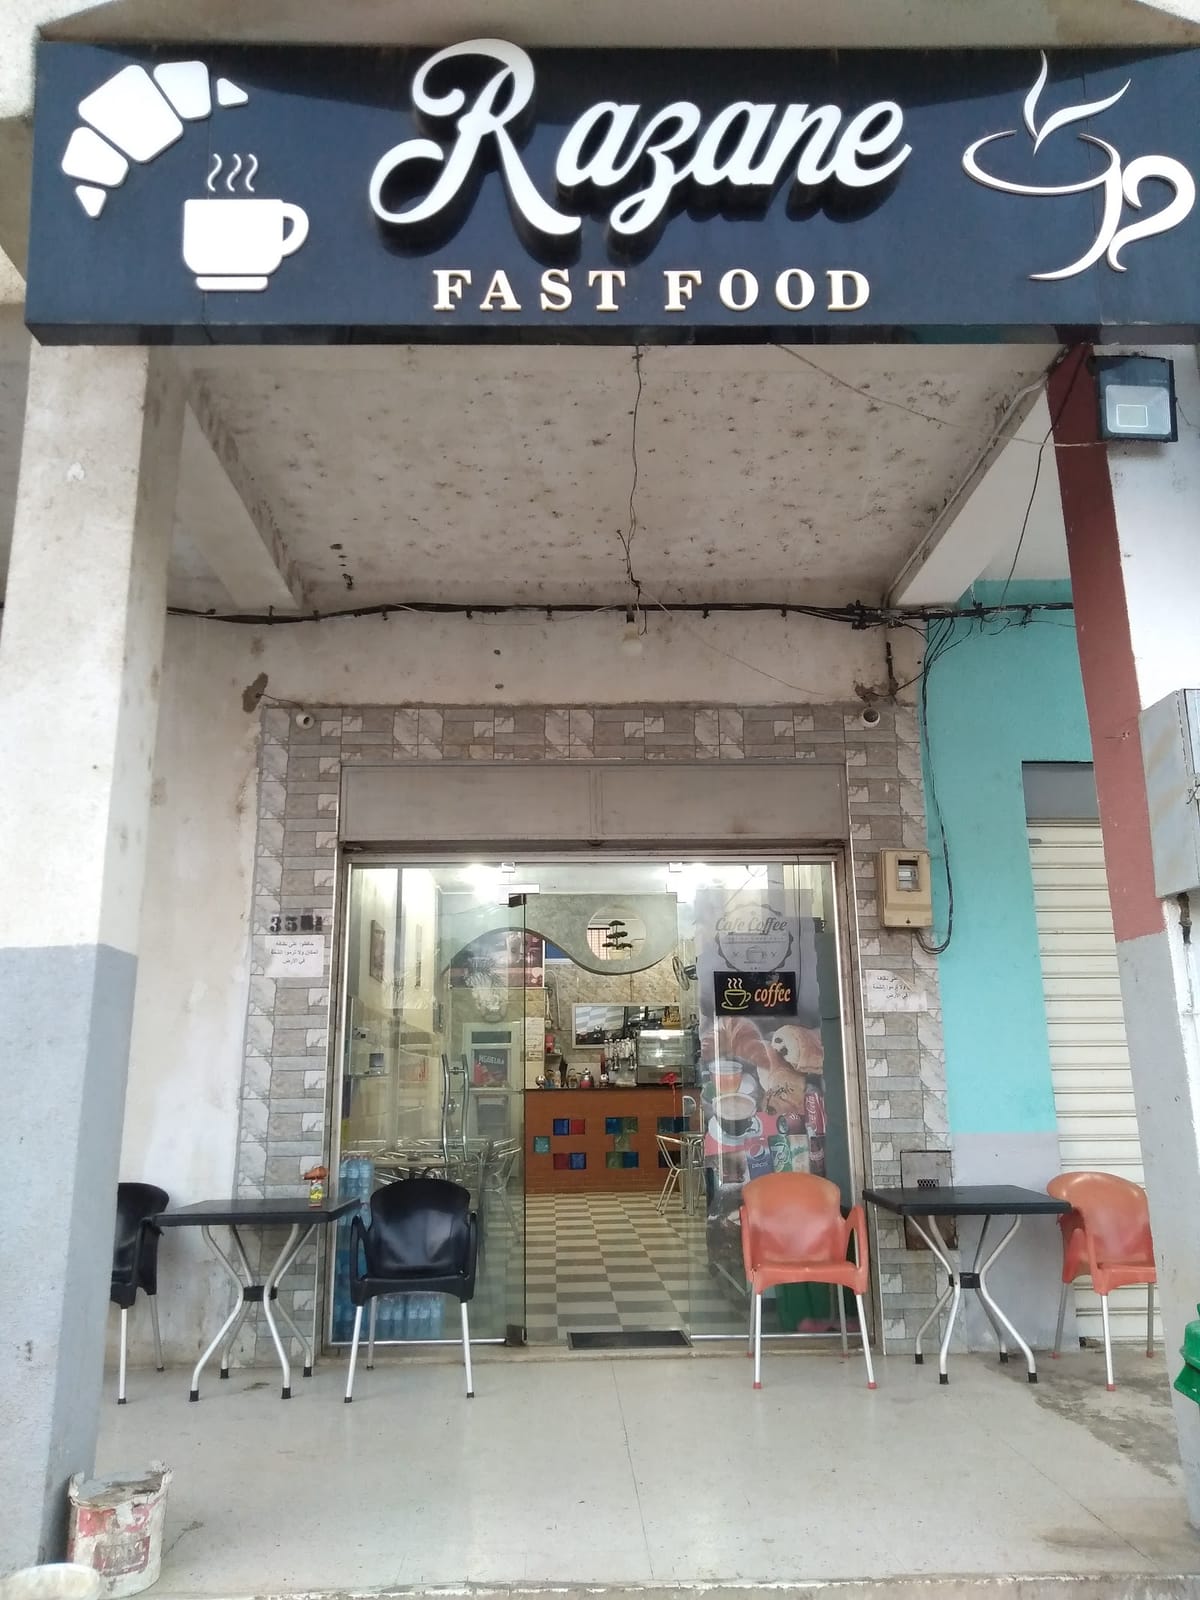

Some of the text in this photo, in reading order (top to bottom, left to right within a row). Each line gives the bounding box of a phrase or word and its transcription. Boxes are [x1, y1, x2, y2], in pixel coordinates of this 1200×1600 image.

[368, 38, 912, 236] Razane
[432, 268, 871, 312] FAST FOOD
[754, 982, 791, 1007] coffee
